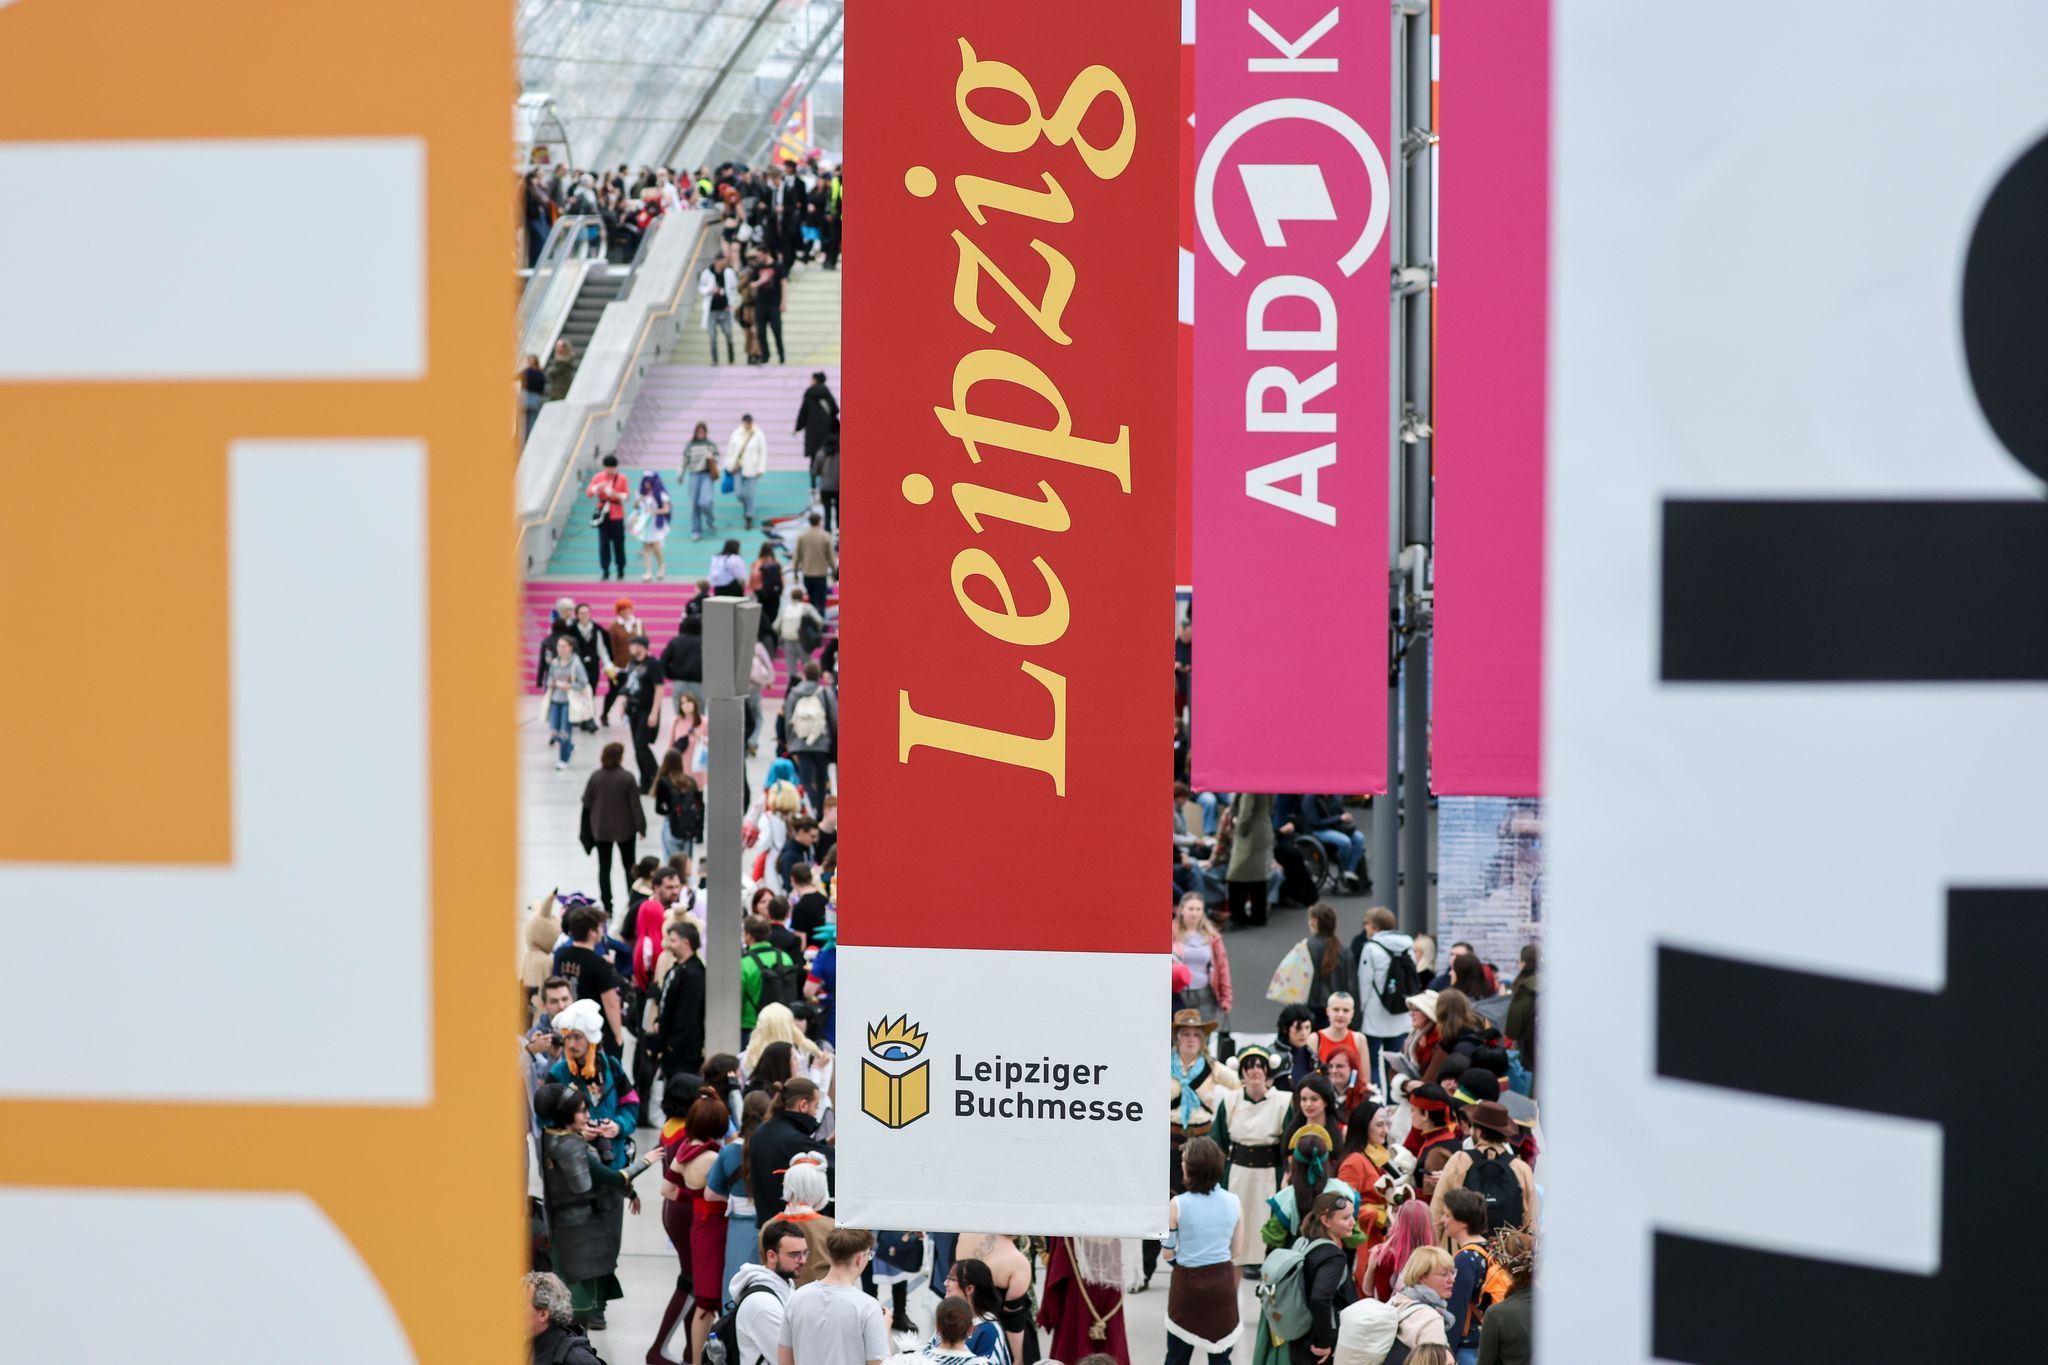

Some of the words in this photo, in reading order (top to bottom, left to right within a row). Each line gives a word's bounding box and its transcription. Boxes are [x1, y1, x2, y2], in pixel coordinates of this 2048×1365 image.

[898, 36, 1137, 798] Leipzig
[1245, 274, 1338, 527] ARD
[955, 1053, 1110, 1091] Leipziger
[955, 1089, 1145, 1122] Buchmesse
